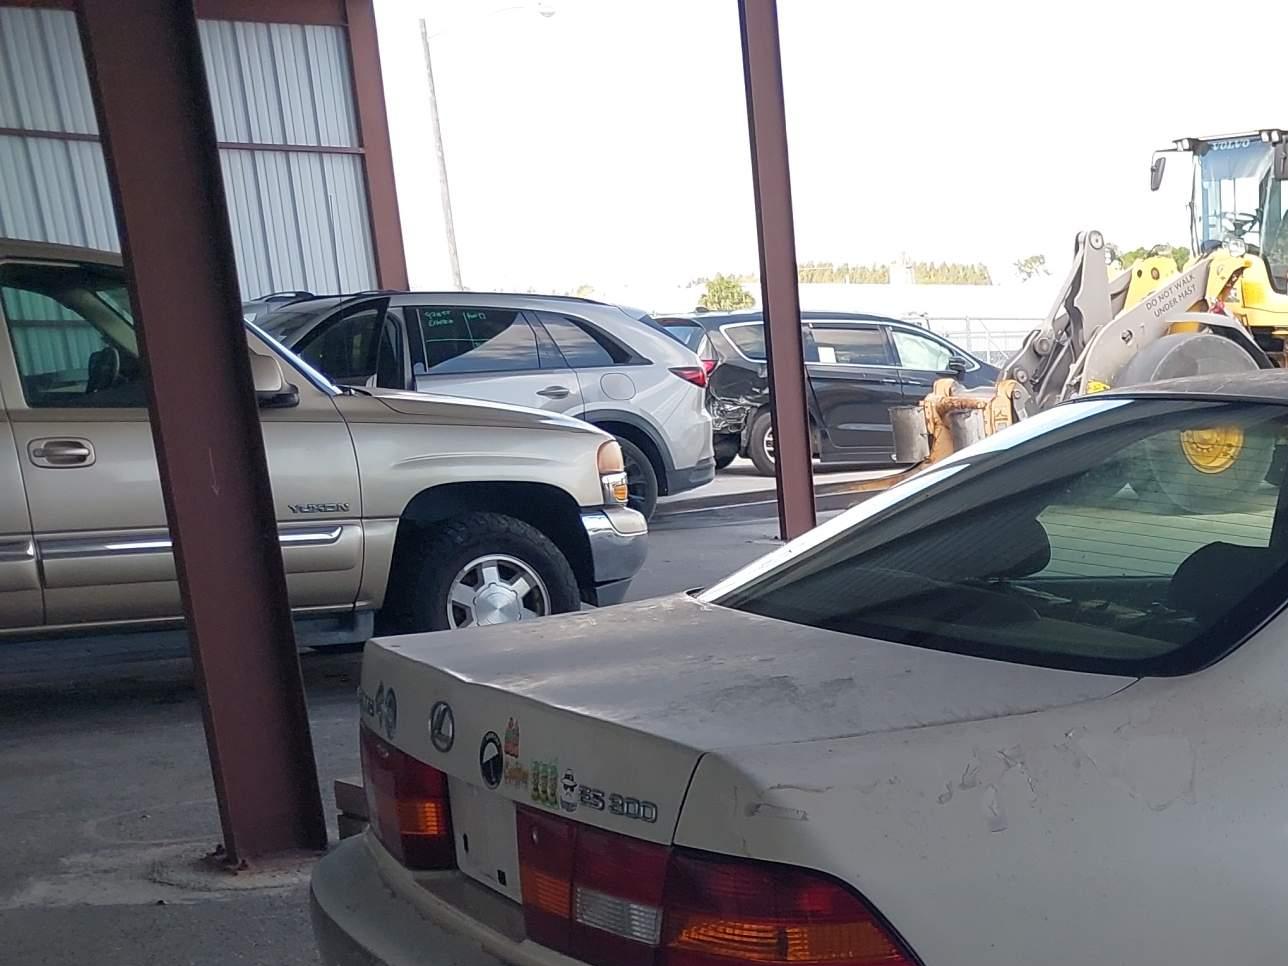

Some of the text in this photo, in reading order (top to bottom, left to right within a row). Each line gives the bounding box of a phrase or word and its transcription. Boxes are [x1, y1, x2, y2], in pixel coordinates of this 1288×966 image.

[1211, 138, 1250, 151] VOLVO
[1145, 274, 1195, 311] DO NOT WALK
[1153, 283, 1197, 318] UNDER MAST
[287, 502, 351, 514] YUKON
[578, 784, 658, 824] ES 300
